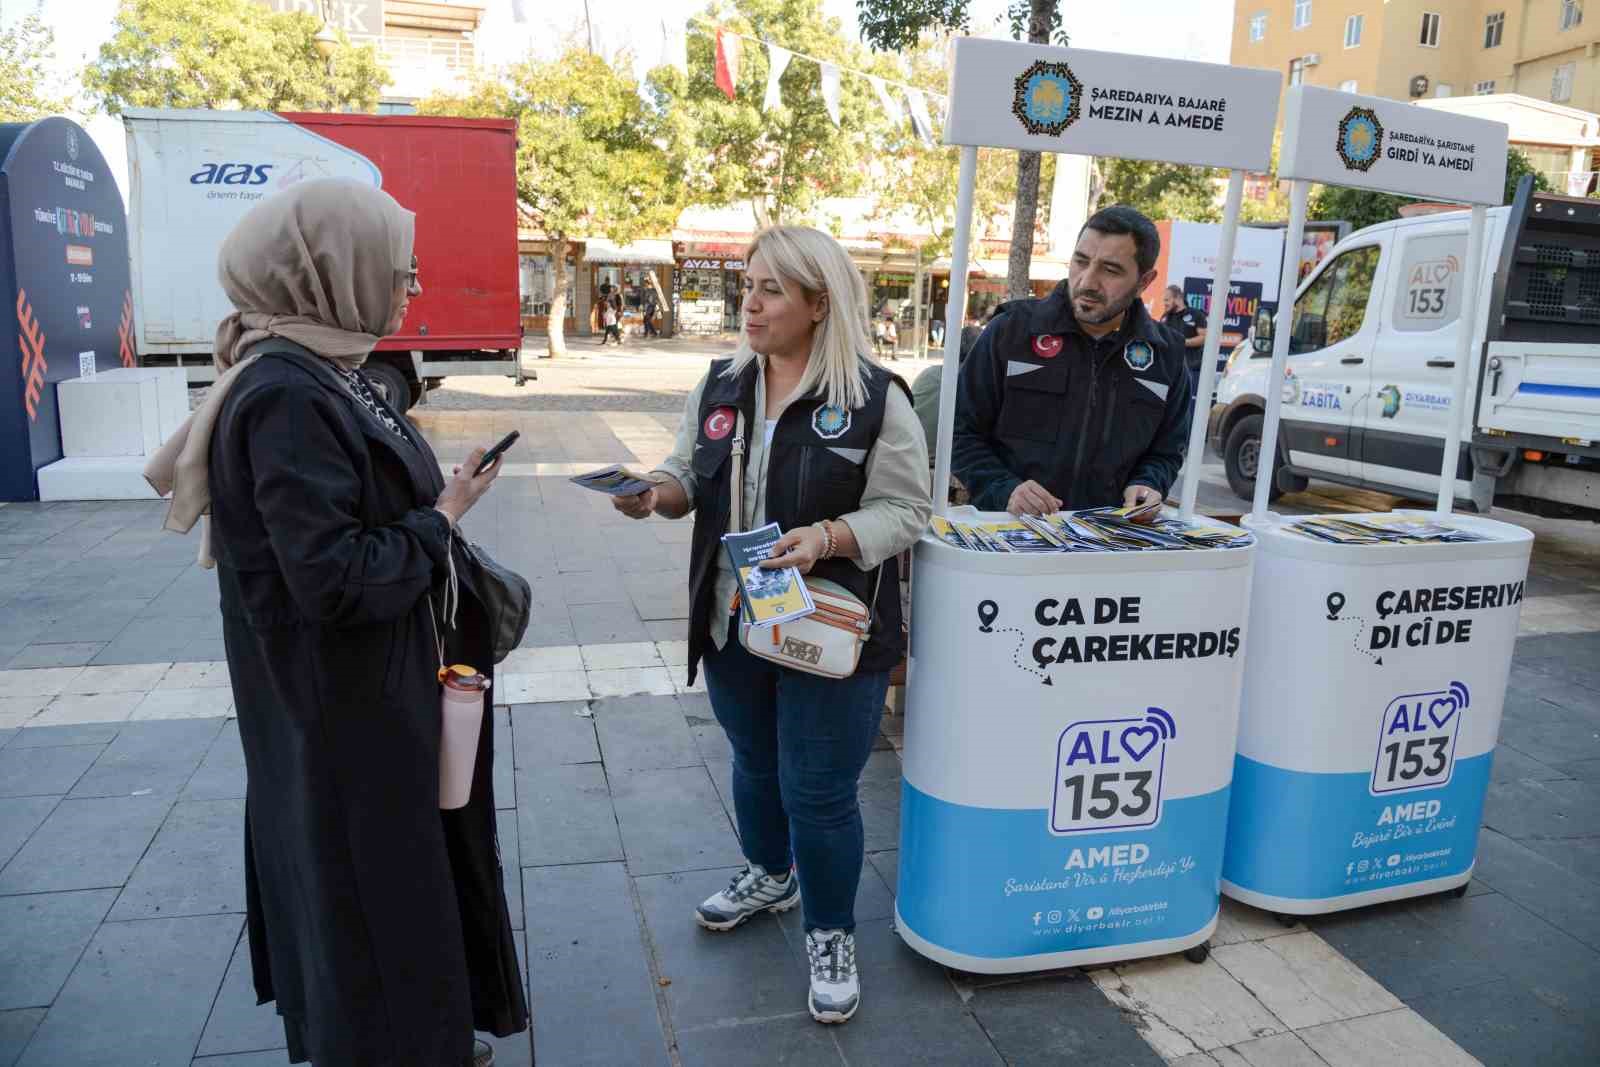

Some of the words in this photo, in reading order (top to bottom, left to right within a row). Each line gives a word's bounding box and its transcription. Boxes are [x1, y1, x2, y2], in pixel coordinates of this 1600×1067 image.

[1091, 87, 1173, 107] ŞAREDARIYA
[1178, 96, 1227, 112] BAJARÊ
[1088, 104, 1142, 123] MEZIN
[1148, 112, 1160, 125] A
[1164, 113, 1224, 131] AMEDÊ
[1422, 151, 1436, 166] YA
[190, 163, 273, 186] aras
[682, 260, 720, 269] AYAZ
[1228, 296, 1257, 317] YOLU
[1409, 288, 1446, 314] 153
[1034, 598, 1086, 627] CA
[1093, 597, 1141, 625] DE
[1376, 580, 1524, 620] ÇARESERIYA
[1370, 625, 1401, 650] DI
[1405, 616, 1433, 647] CÎ
[1435, 619, 1472, 644] DE
[1032, 627, 1241, 670] ÇAREKERDIŞ
[1385, 736, 1449, 782] 153
[1063, 770, 1153, 821] 153
[1377, 799, 1441, 826] AMED
[1064, 843, 1150, 871] AMED
